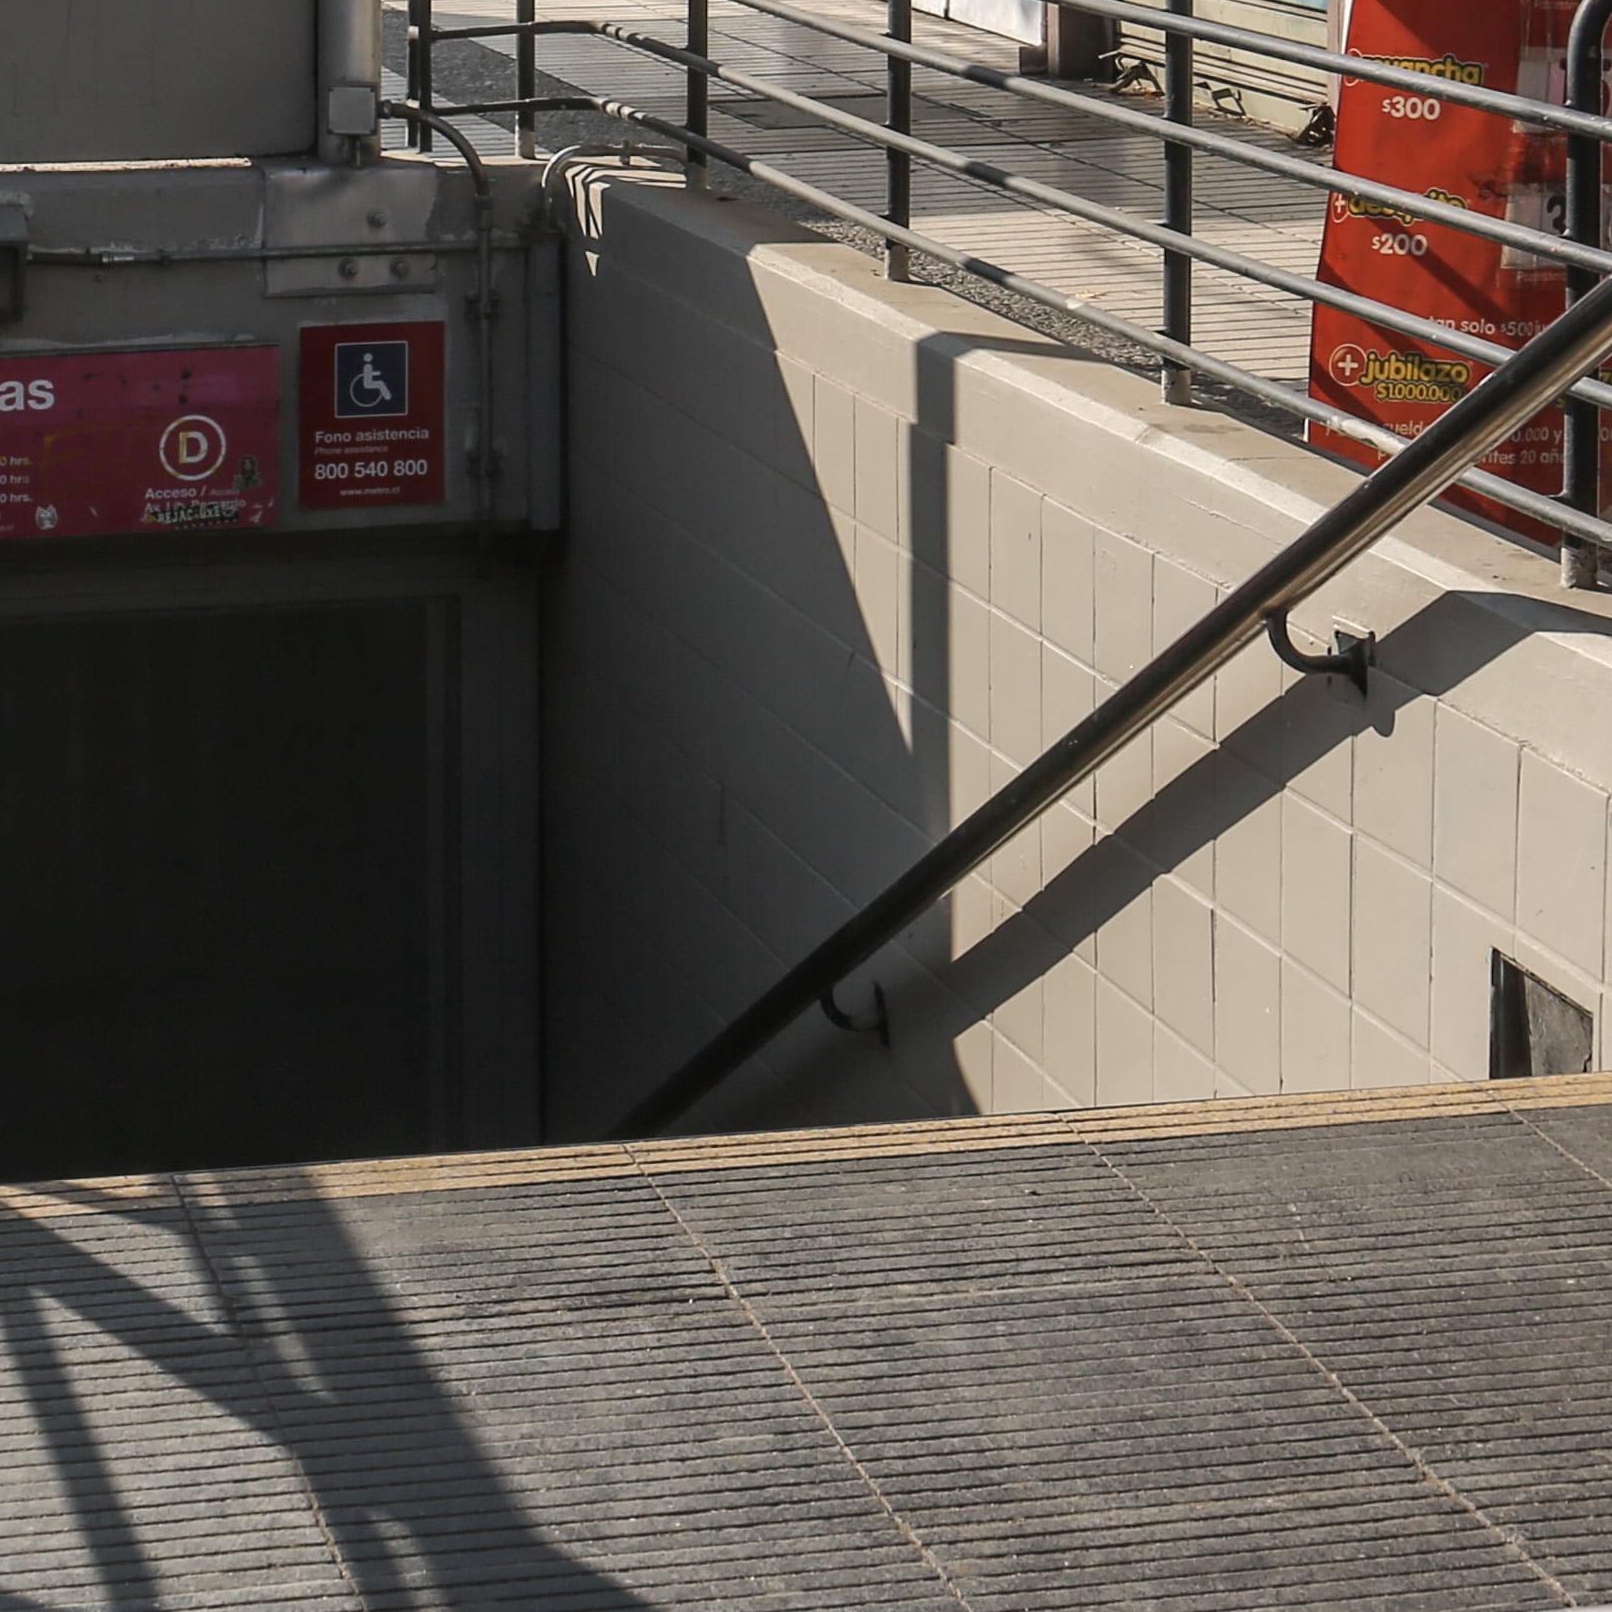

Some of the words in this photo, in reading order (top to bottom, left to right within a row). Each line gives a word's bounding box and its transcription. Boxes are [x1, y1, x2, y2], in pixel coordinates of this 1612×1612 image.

[1381, 94, 1442, 121] $300
[1371, 232, 1429, 257] $200
[1460, 315, 1497, 335] solo
[1362, 352, 1469, 385] jubilazo
[179, 430, 209, 464] D
[314, 430, 351, 445] Fono
[354, 426, 430, 442] asistencia
[314, 463, 349, 480] 800
[354, 460, 389, 478] 540
[393, 459, 428, 476] 800
[144, 487, 198, 500] Acceso
